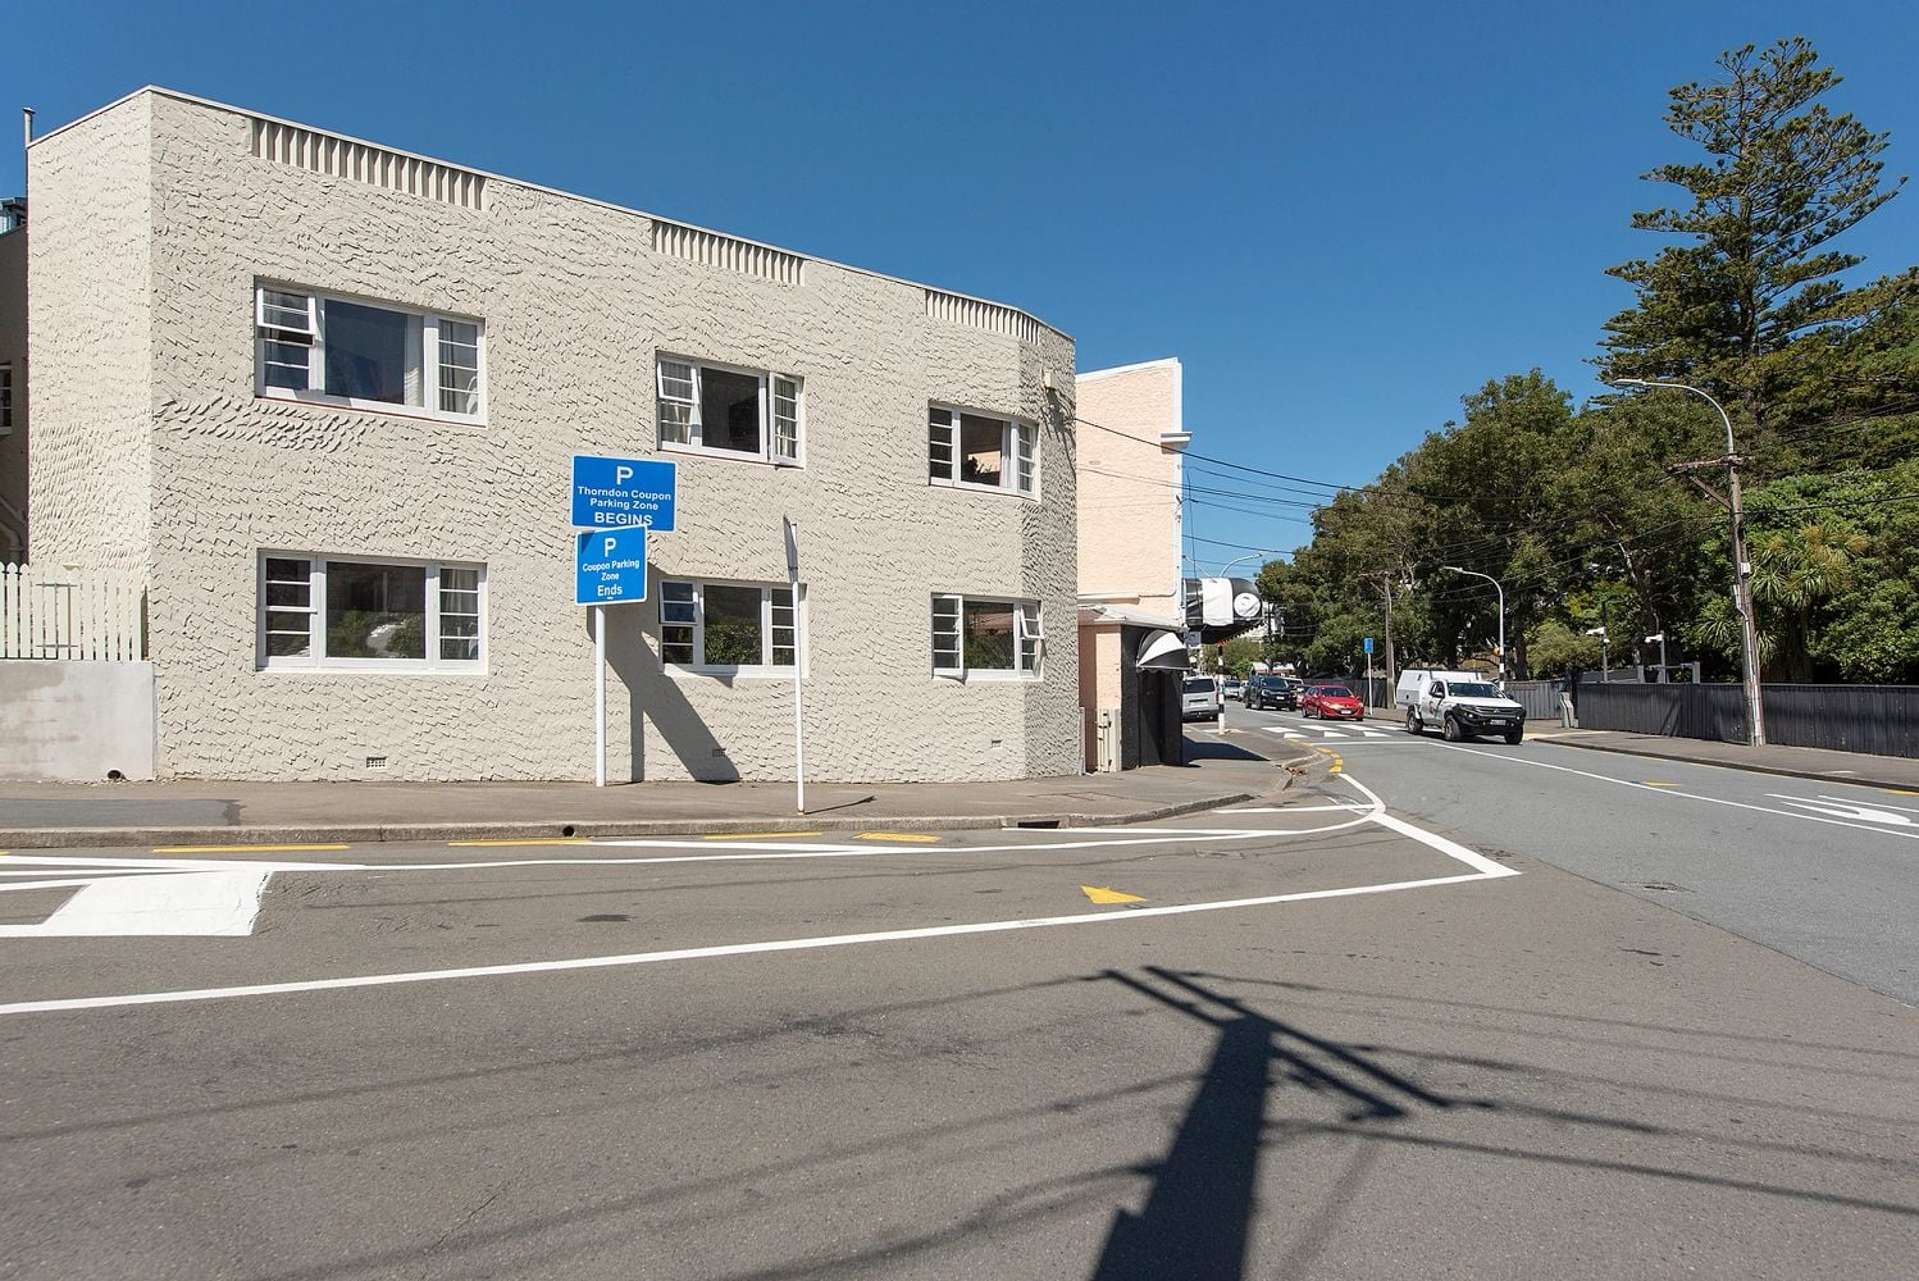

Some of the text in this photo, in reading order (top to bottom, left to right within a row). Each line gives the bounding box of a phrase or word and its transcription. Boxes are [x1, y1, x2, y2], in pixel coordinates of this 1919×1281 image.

[616, 466, 634, 485] P
[577, 486, 671, 501] Thorndon Coupon
[590, 498, 659, 510] Parking Zone
[594, 512, 653, 526] BEGINS
[604, 537, 616, 557] P
[582, 559, 640, 573] Coupon Parking
[601, 572, 619, 581] Zone
[597, 584, 623, 596] Ends
